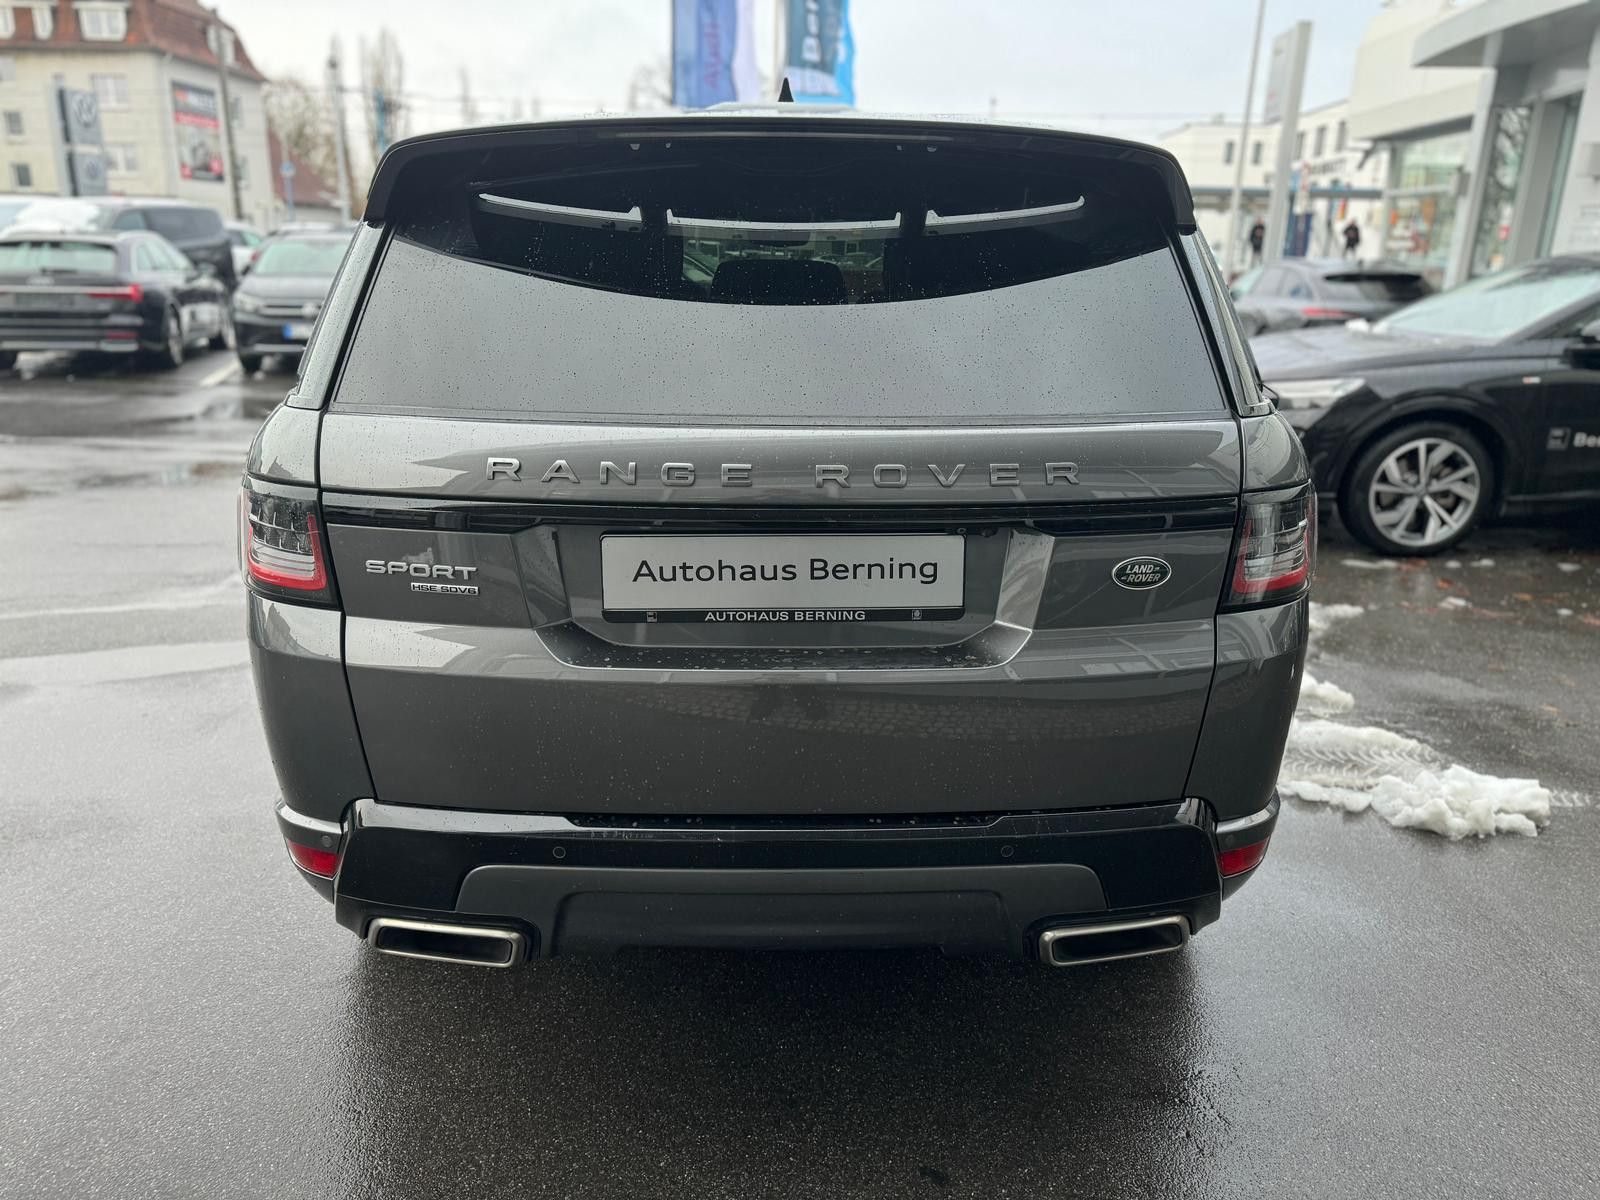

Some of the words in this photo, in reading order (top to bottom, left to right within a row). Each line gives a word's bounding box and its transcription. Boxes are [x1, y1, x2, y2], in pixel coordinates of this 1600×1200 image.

[486, 457, 753, 487] RANGE
[814, 462, 1081, 488] ROVER
[365, 559, 478, 580] SPORT
[632, 559, 797, 582] Autohaus
[810, 557, 938, 585] Berning
[1126, 564, 1154, 574] LAND
[1127, 573, 1161, 583] ROVER
[412, 583, 438, 592] HSE
[440, 585, 477, 595] SDV6
[704, 611, 789, 622] AUTOHAUS
[794, 610, 866, 621] BERNING
